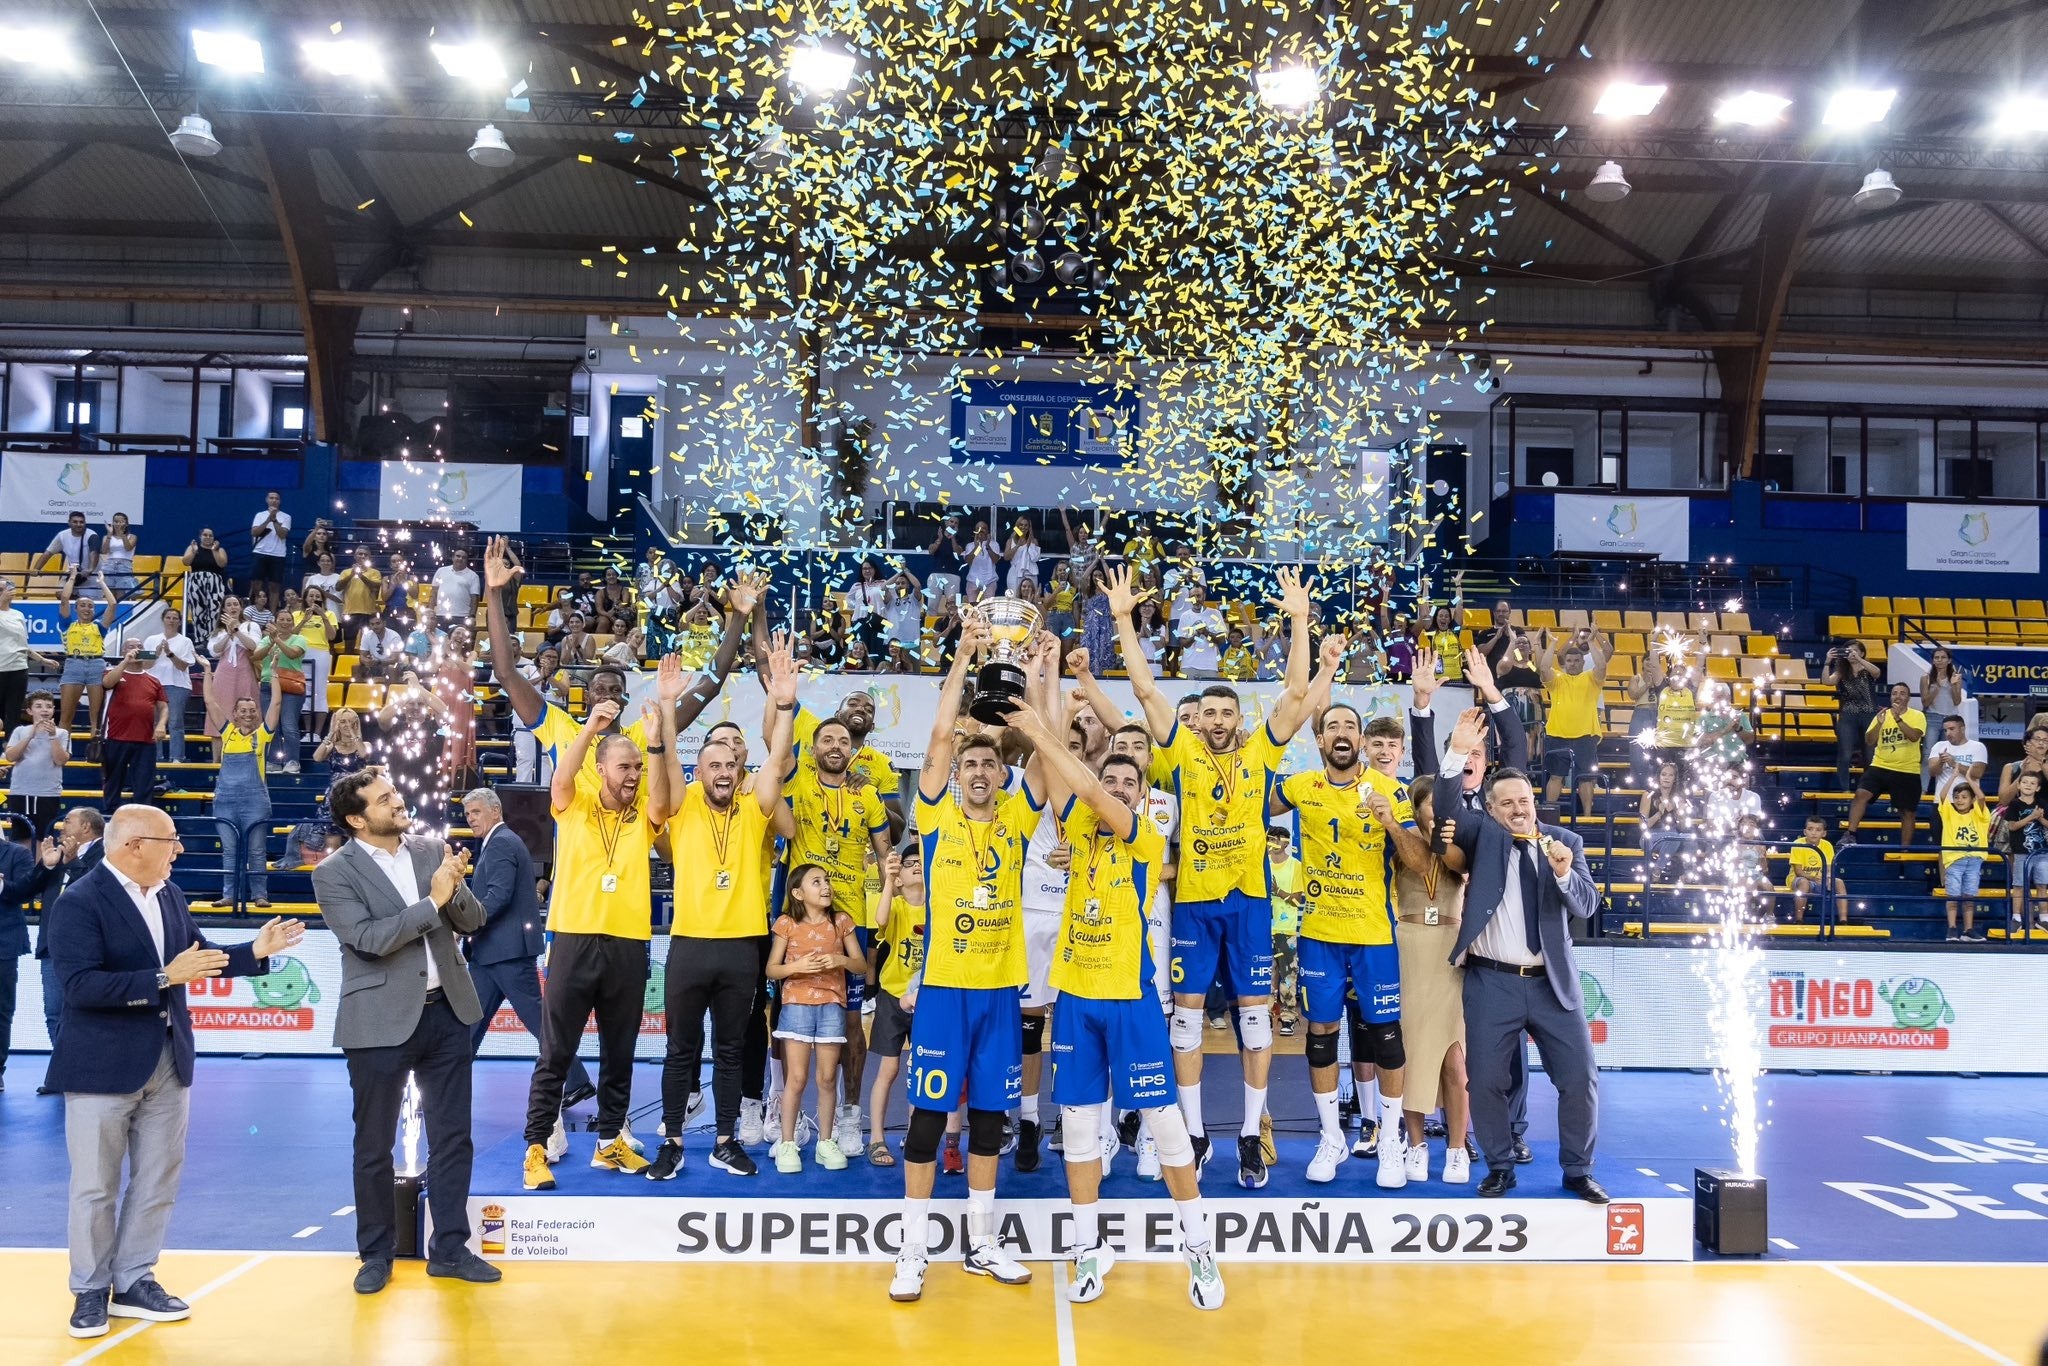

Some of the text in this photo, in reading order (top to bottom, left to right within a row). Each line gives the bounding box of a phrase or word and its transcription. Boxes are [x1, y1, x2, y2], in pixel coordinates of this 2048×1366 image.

[999, 393, 1045, 402] CONSEJERÍA
[1046, 395, 1057, 403] DE
[1948, 558, 1974, 566] Europea
[1328, 817, 1339, 843] 1
[1323, 884, 1365, 896] GUAGUAS
[1170, 956, 1185, 984] 6
[1777, 1031, 1936, 1047] GRUPO JUANPADRÓN
[915, 1066, 948, 1100] 10
[1130, 1074, 1166, 1088] HPS
[511, 1219, 595, 1229] Real Federación
[676, 1211, 1032, 1255] SUPERCOA
[1145, 1201, 1375, 1254] EPAÑA
[1390, 1212, 1528, 1253] 2023
[511, 1233, 559, 1244] Española
[511, 1246, 568, 1256] de Voleibol
